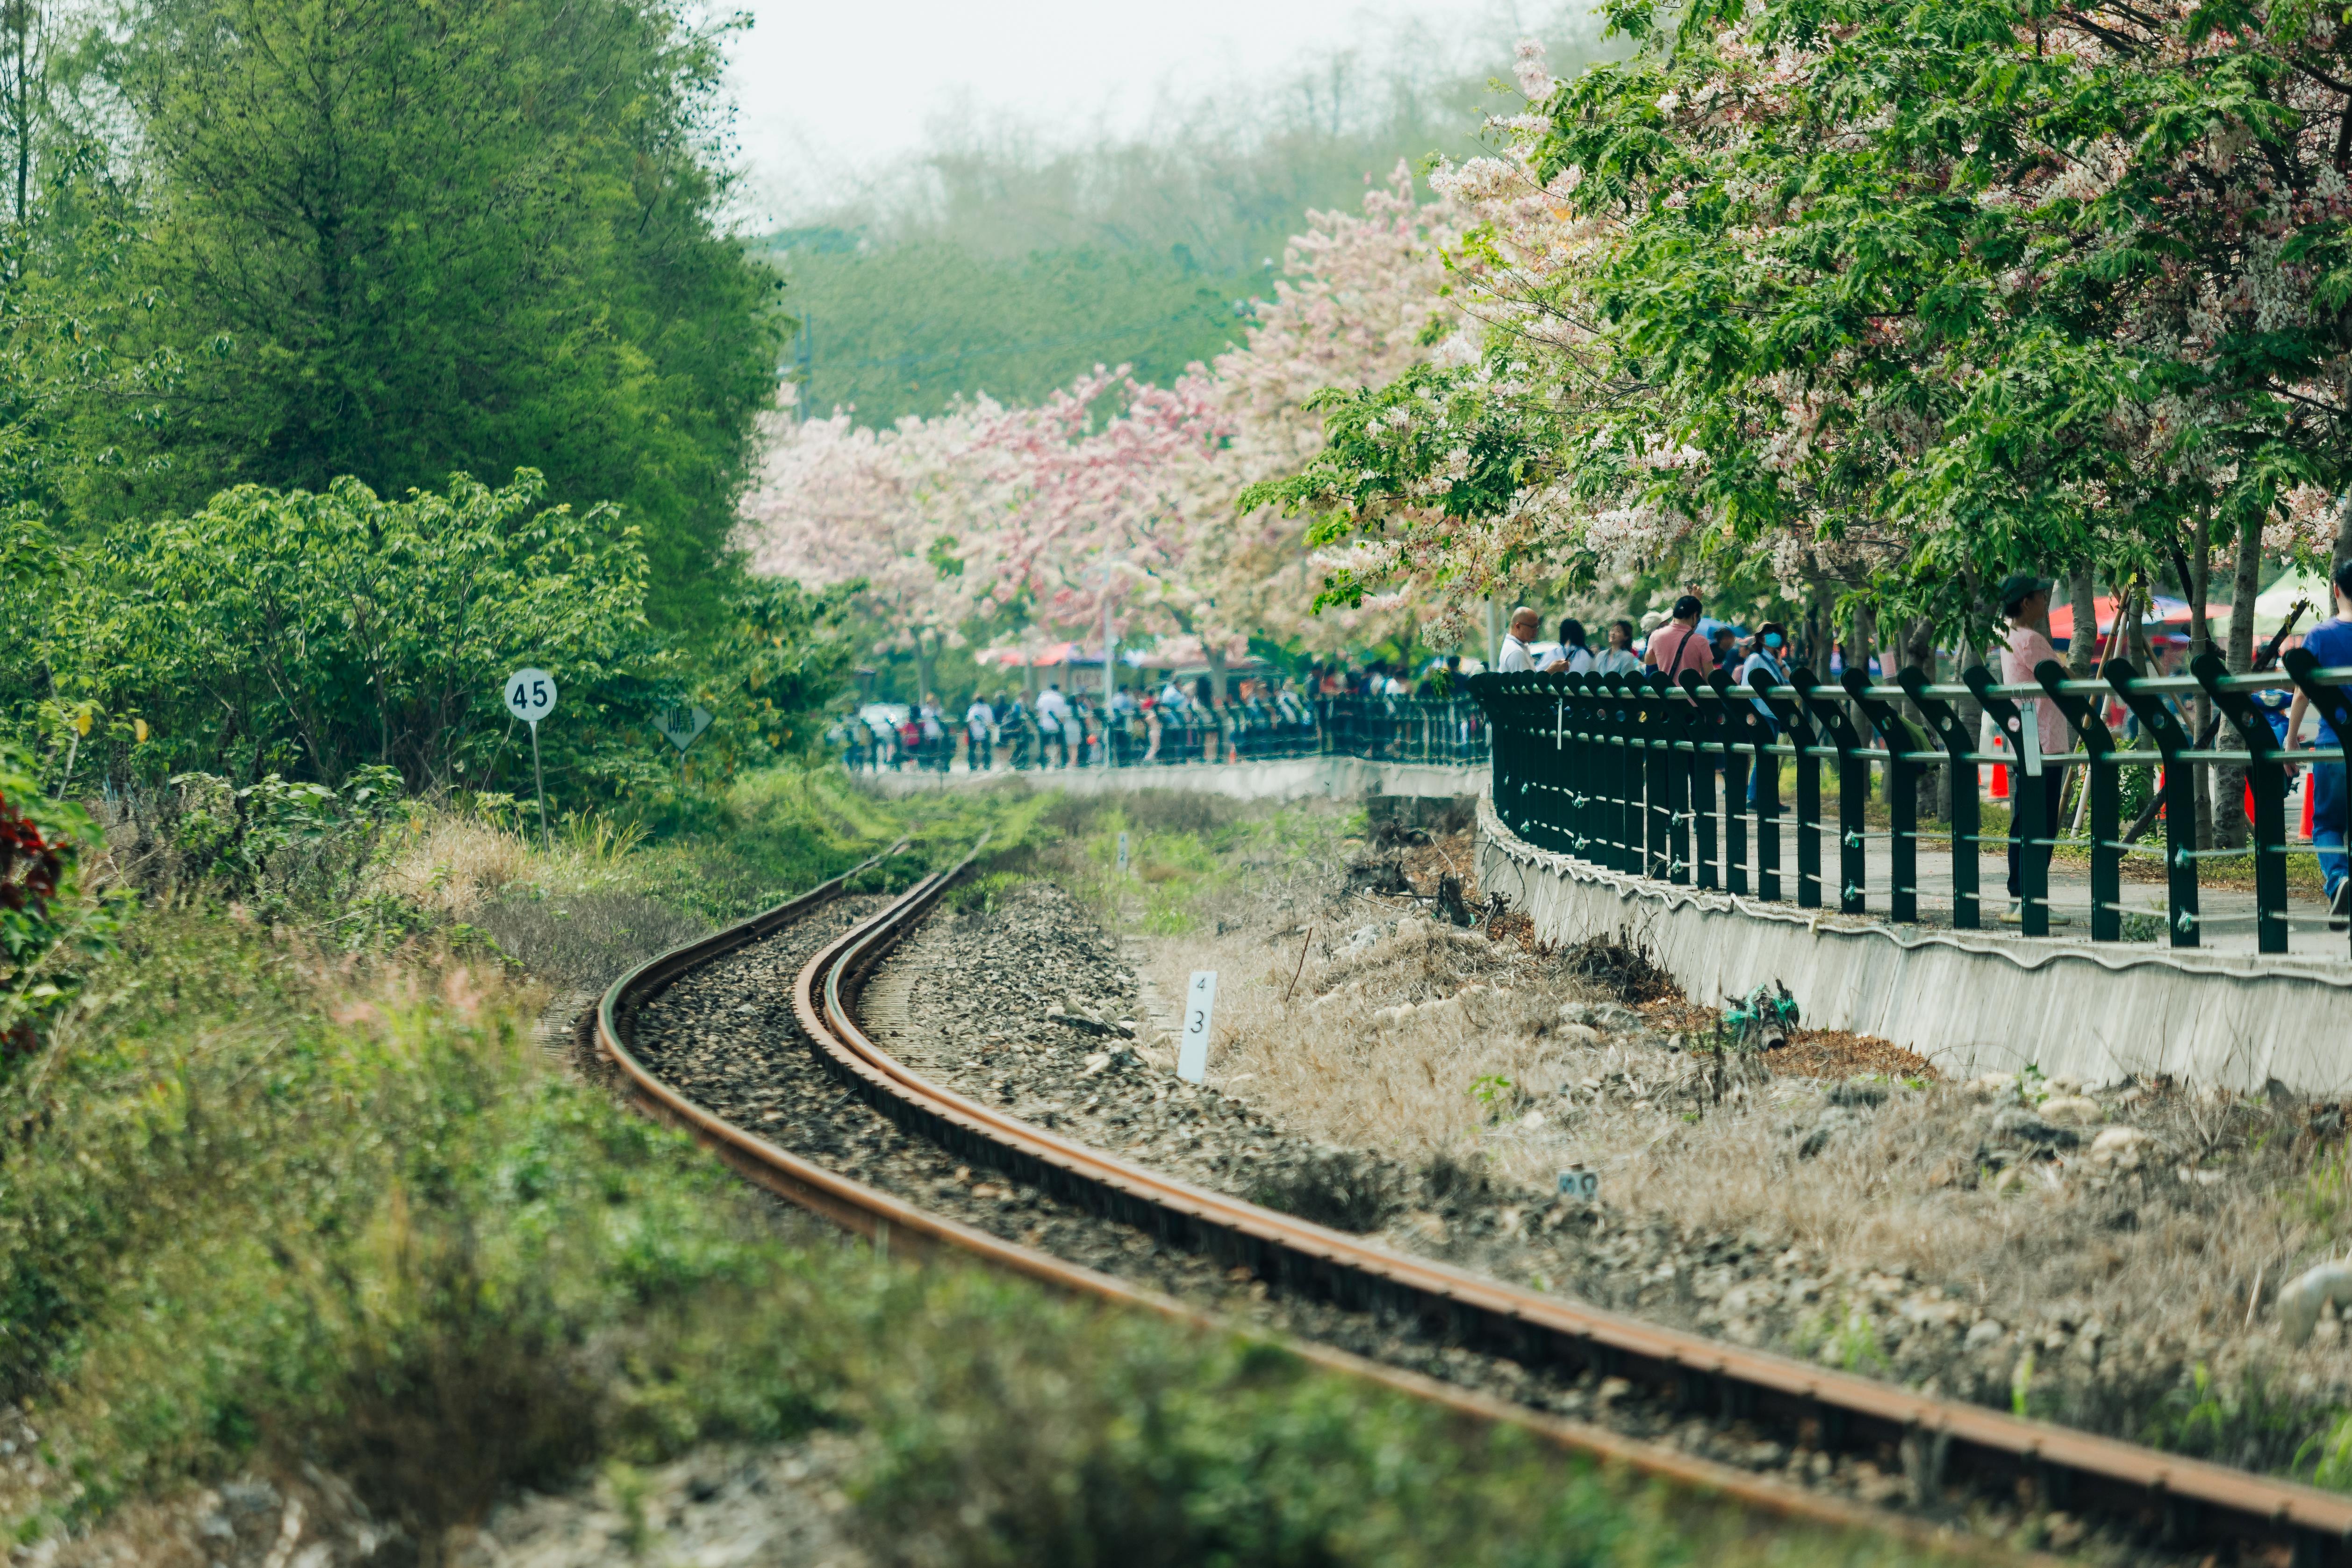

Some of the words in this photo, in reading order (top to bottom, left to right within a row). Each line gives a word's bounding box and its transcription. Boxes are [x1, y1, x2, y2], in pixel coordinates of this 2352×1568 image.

[513, 680, 547, 709] 45
[1197, 977, 1206, 992] 4
[1190, 1010, 1204, 1033] 3
